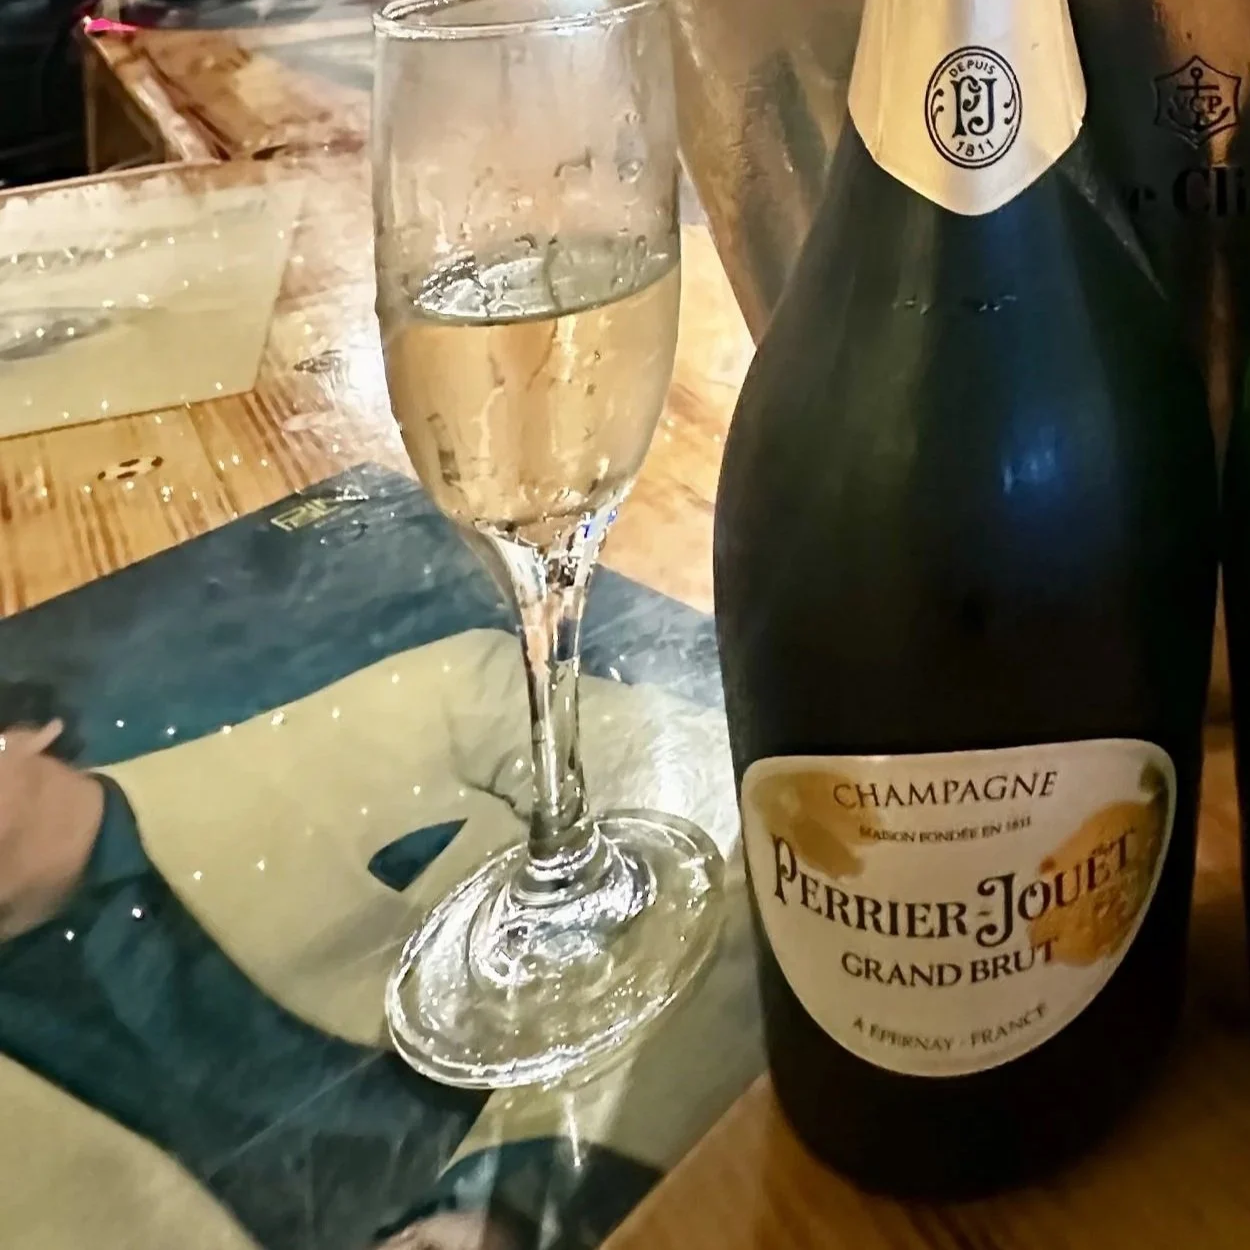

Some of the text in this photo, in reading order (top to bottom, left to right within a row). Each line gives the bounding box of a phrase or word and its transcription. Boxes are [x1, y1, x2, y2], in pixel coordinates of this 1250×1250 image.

[948, 59, 996, 78] DEPUIS
[956, 138, 996, 159] 1811
[832, 769, 1059, 810] CHAMPAGNE
[841, 936, 1061, 989] GRAND BRUT
[970, 1002, 1048, 1046] FRANCE
